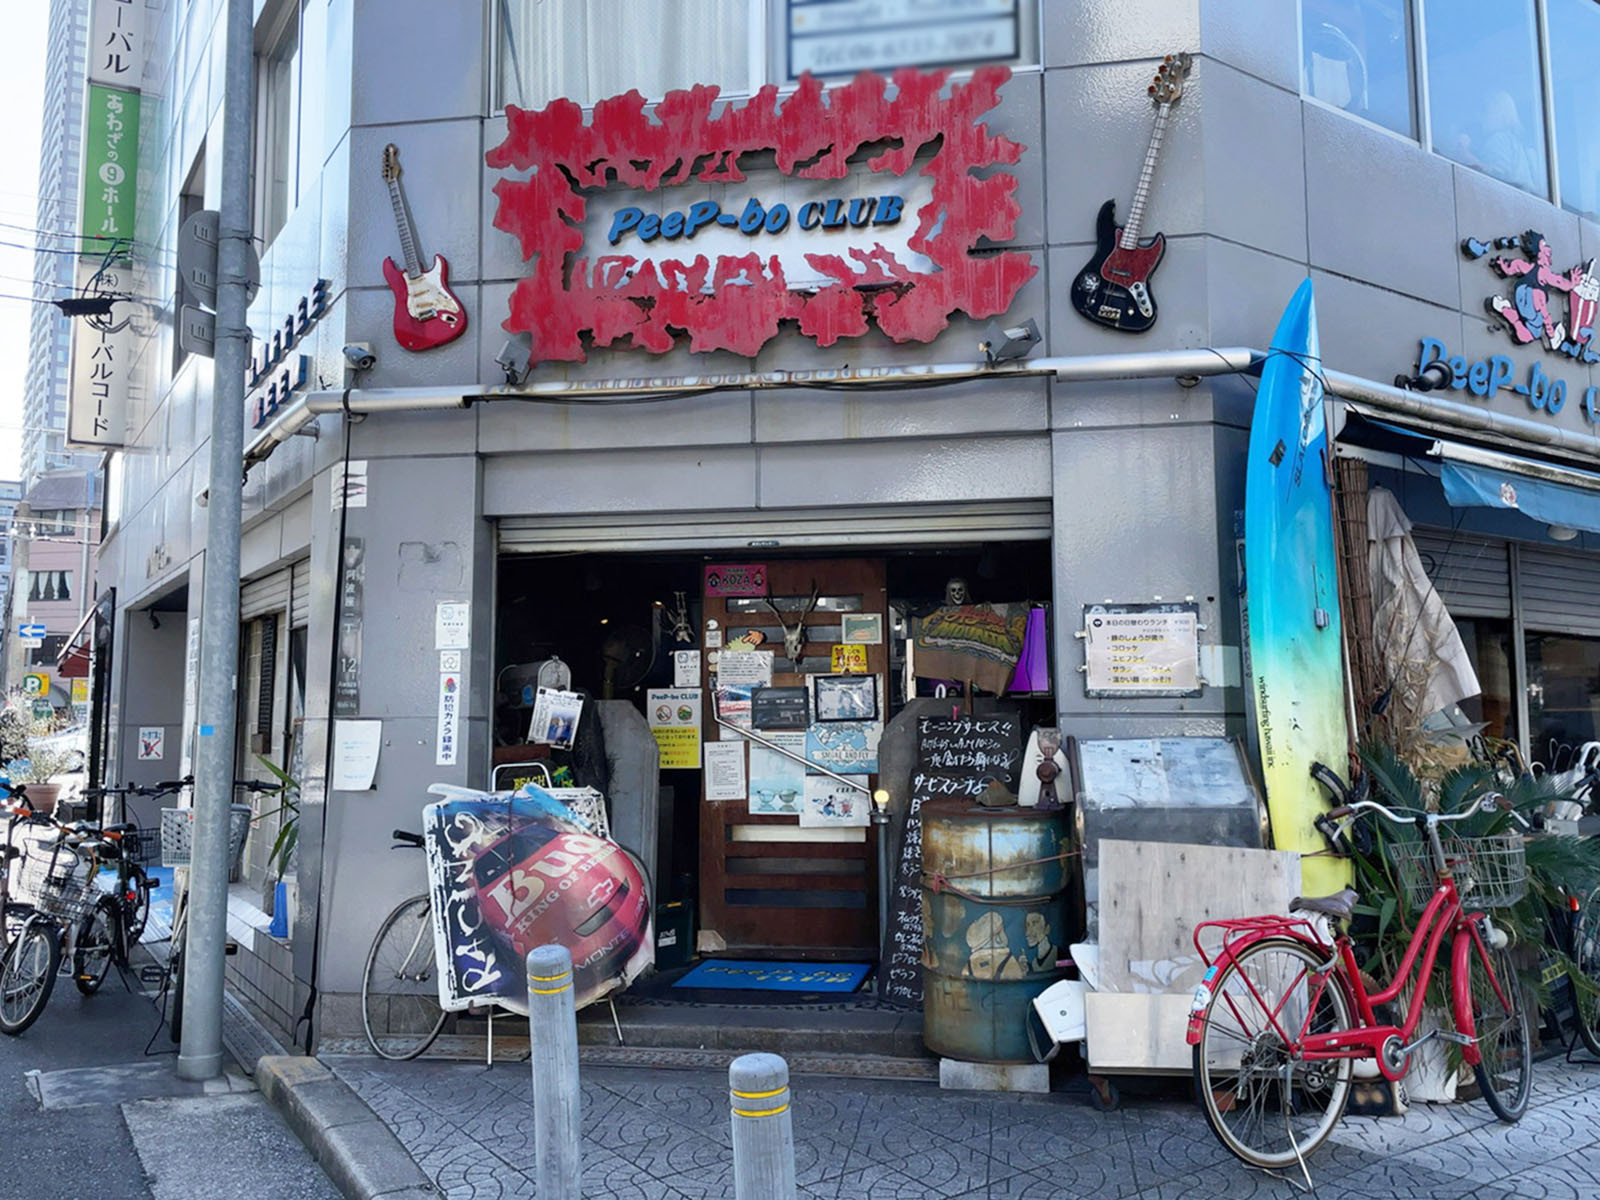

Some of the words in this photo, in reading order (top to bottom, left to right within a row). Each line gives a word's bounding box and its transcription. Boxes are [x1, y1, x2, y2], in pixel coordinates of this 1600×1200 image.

[103, 0, 134, 73] ーバル
[797, 195, 906, 230] CLUB
[722, 574, 750, 585] KOZA
[341, 657, 356, 673] 12
[1258, 676, 1271, 727] windsurfing
[486, 834, 608, 929] Bud
[514, 890, 560, 934] KING
[558, 869, 580, 891] OF
[574, 930, 631, 973] MONTE
